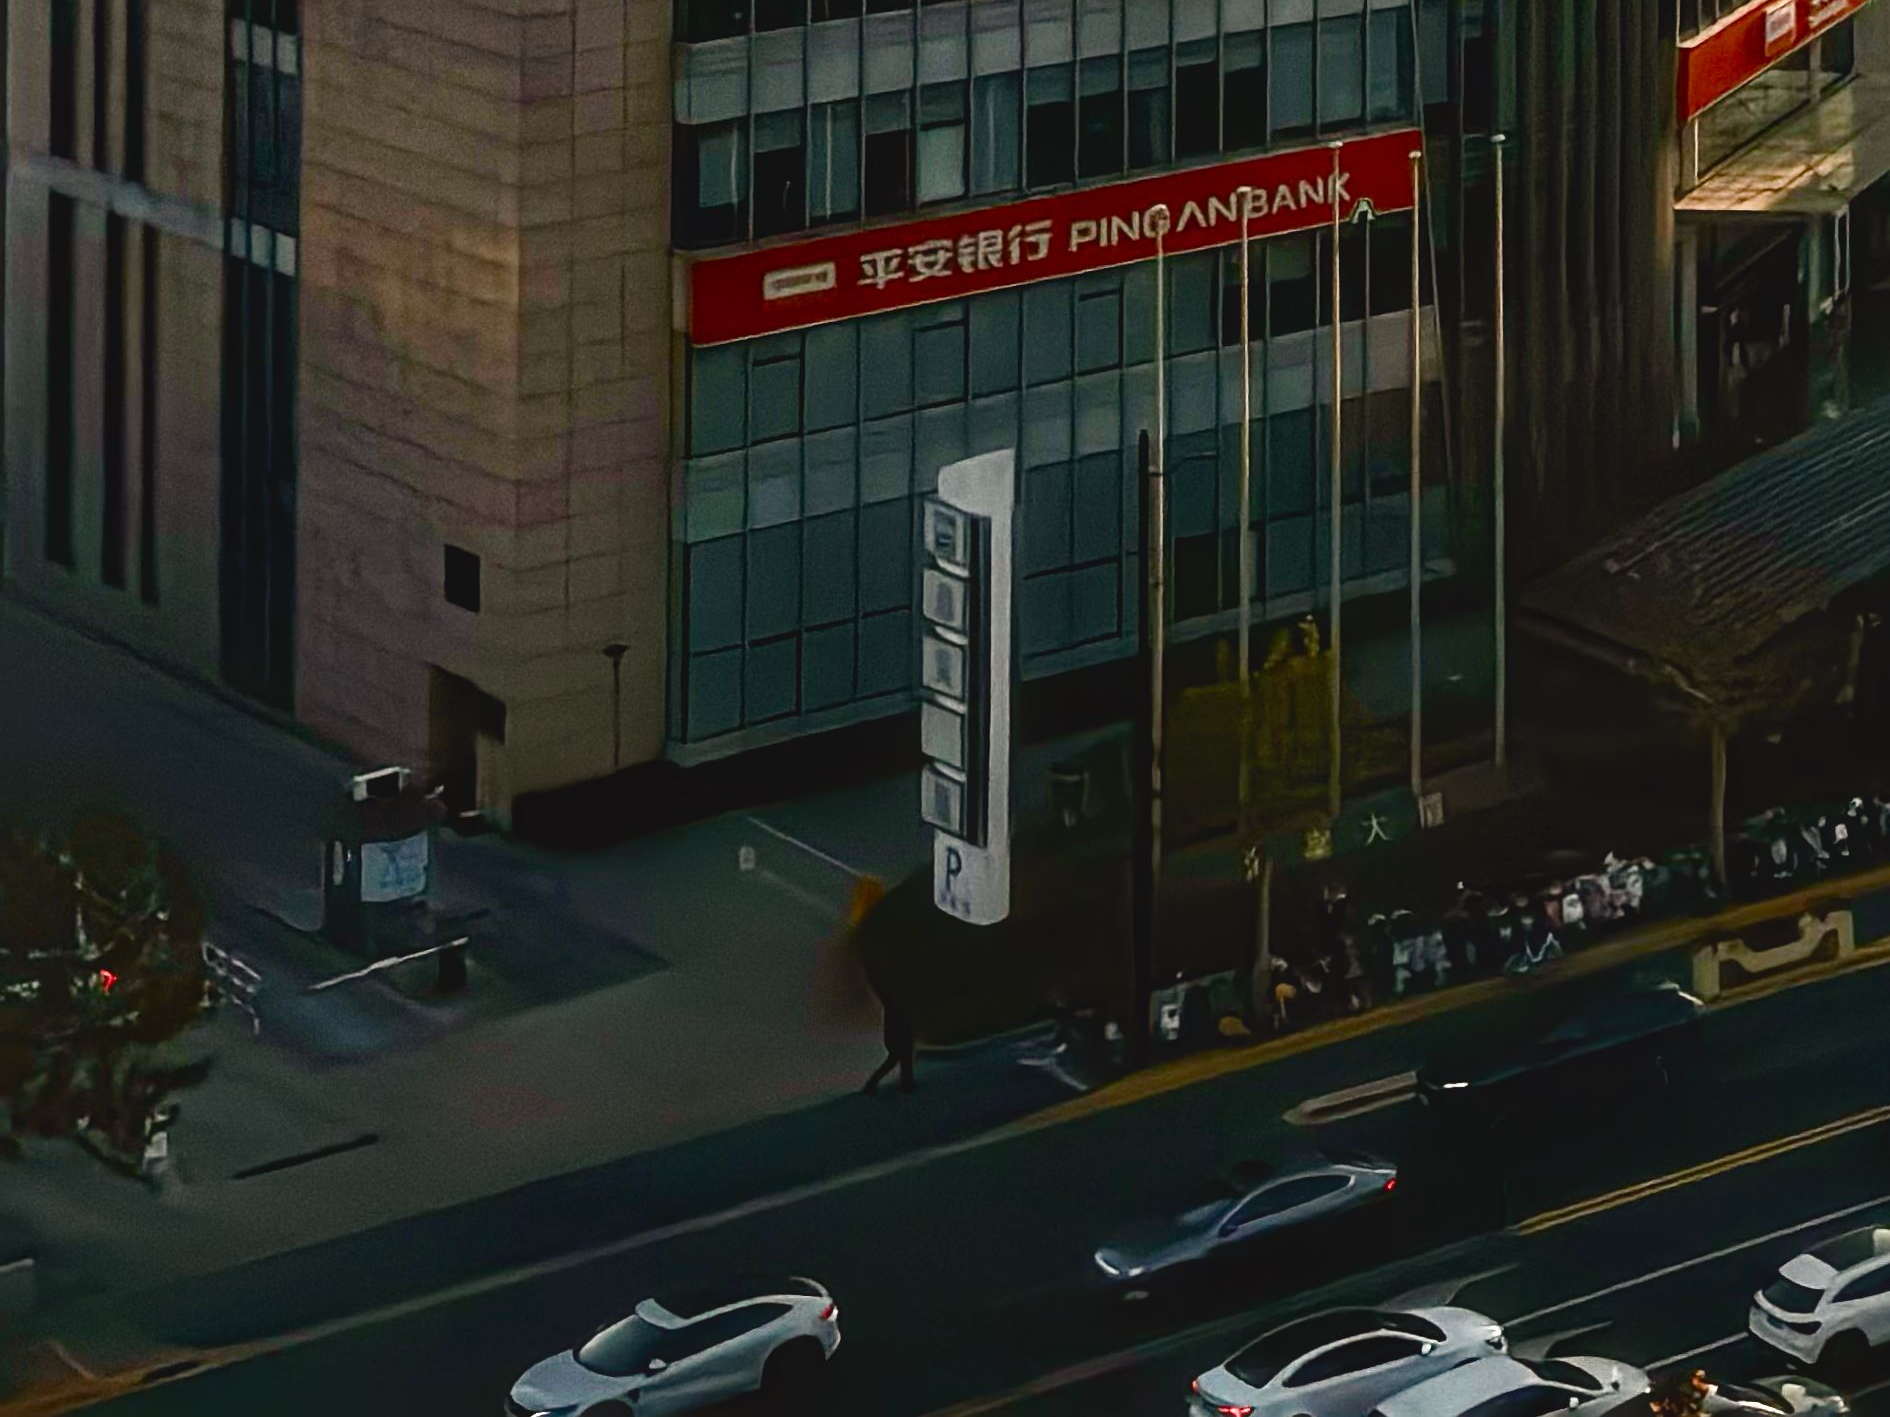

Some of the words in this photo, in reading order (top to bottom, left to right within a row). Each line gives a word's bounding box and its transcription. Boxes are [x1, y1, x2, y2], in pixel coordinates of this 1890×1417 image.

[856, 220, 1054, 290] 平安银行
[945, 845, 963, 892] P
